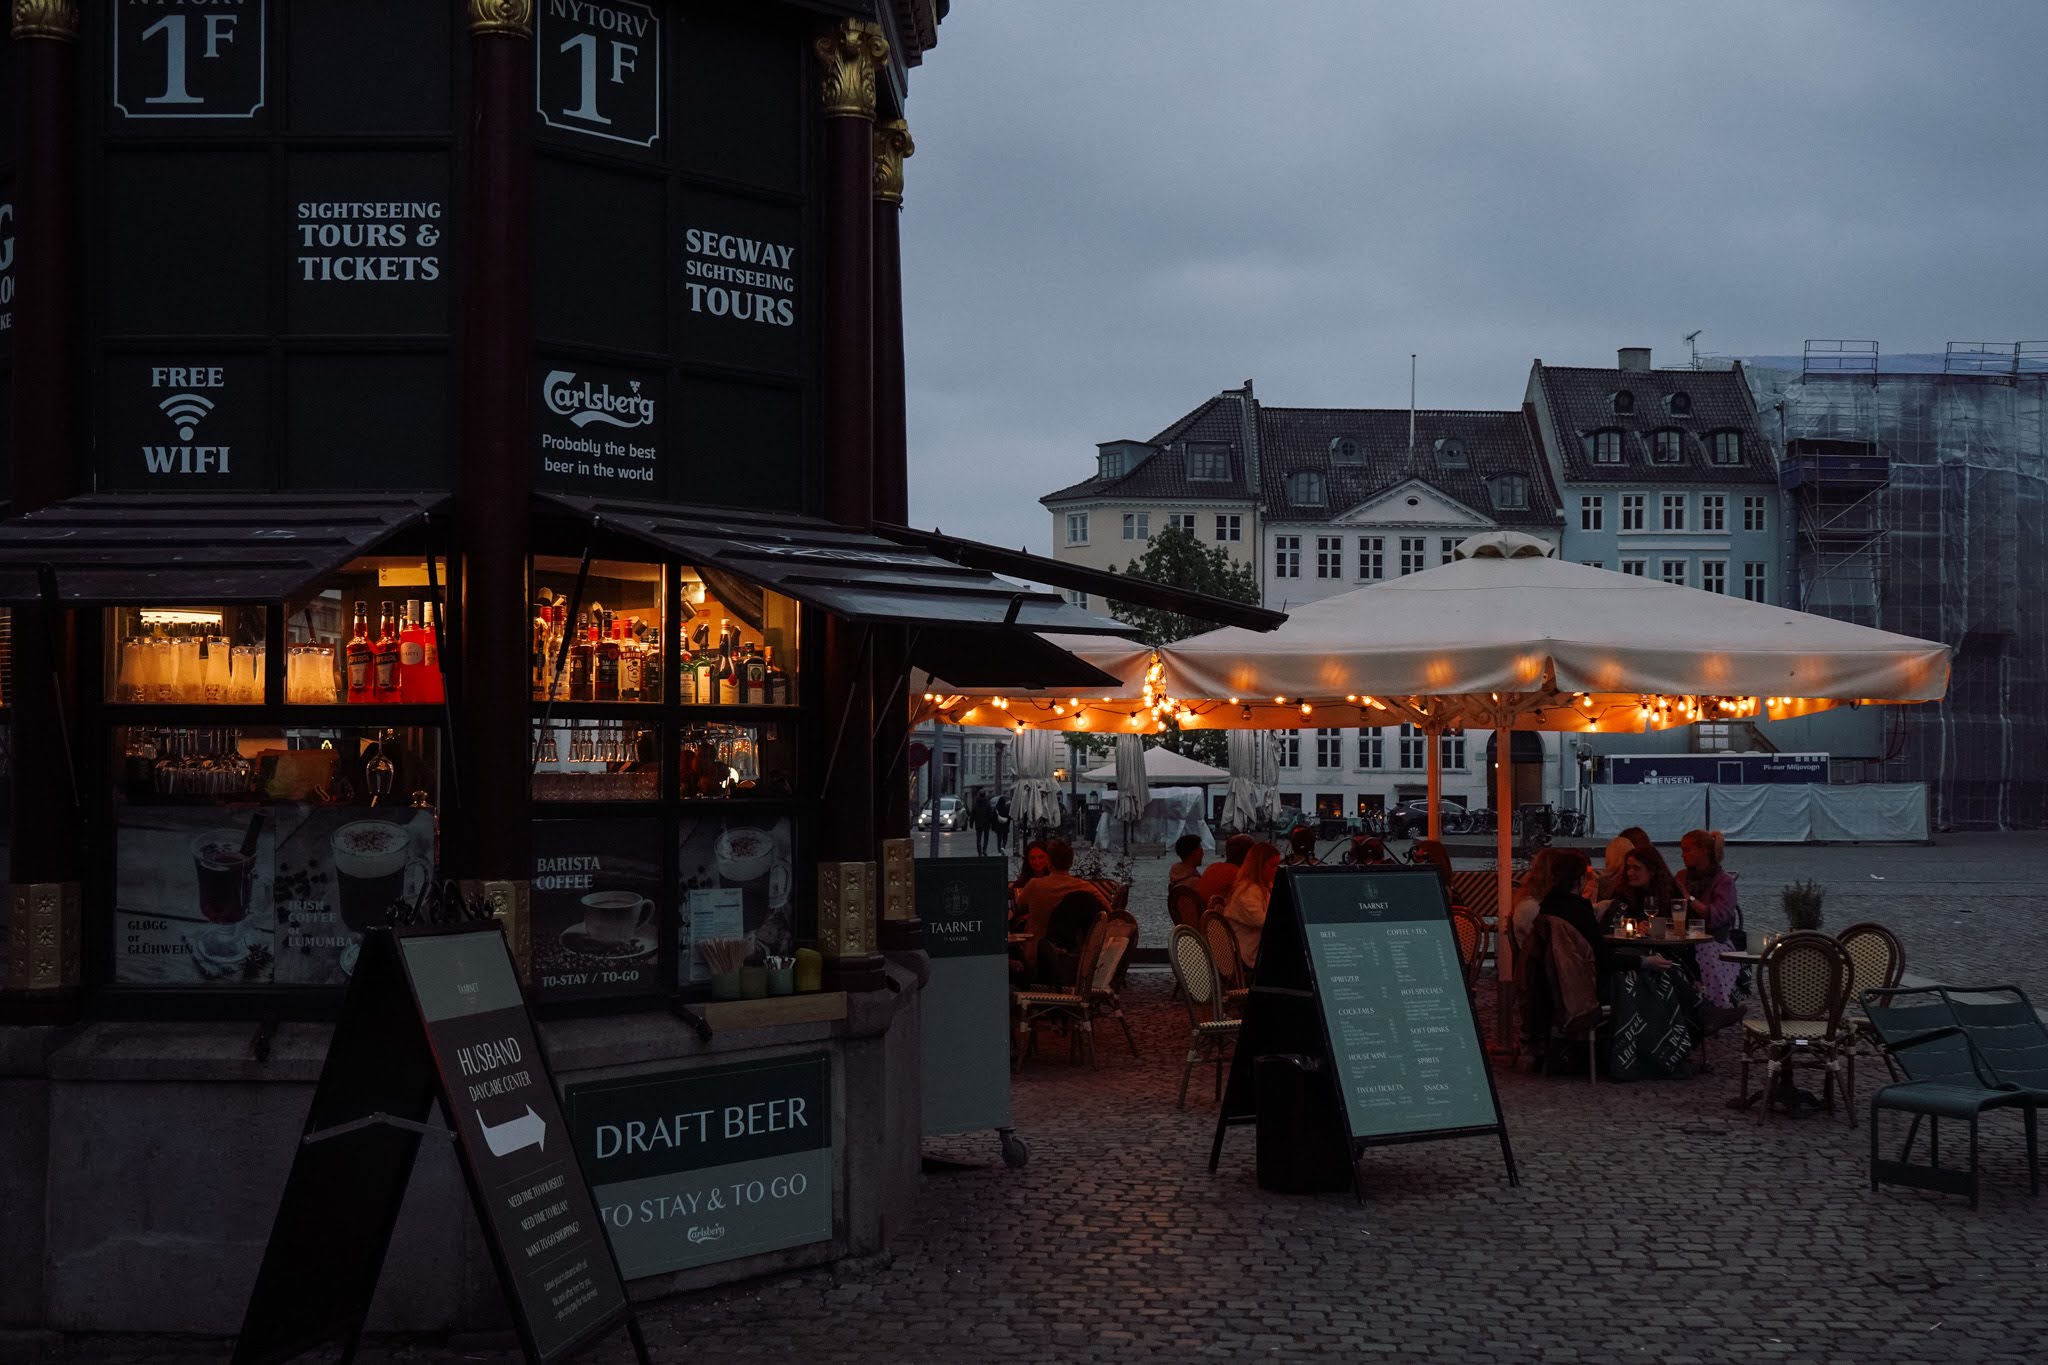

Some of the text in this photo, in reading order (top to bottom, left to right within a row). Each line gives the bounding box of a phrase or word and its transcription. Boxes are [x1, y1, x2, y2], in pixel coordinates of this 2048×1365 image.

[549, 0, 648, 38] NYTORV
[298, 203, 440, 218] SIGHTSEEING
[299, 224, 439, 246] TOURS &
[686, 228, 794, 270] SEGWAY
[298, 257, 439, 280] TICKETS
[686, 259, 794, 293] SIGHTSEEING
[685, 282, 794, 327] TOURS
[152, 368, 224, 387] FREE
[544, 371, 654, 427] Carlsberg
[542, 433, 656, 460] Probably the best
[142, 447, 230, 473] WIFI
[544, 459, 655, 482] beer in the world
[536, 856, 601, 872] BARISTA
[536, 873, 593, 890] COFFEE
[288, 901, 324, 911] IRISH
[1358, 902, 1389, 910] TAARNET
[288, 912, 337, 924] COFFEE
[929, 920, 983, 934] TAARNET
[288, 927, 300, 935] or
[288, 936, 353, 947] LUMUMBA
[128, 943, 193, 954] GLÜHWEIN
[542, 974, 588, 987] TO-STAY
[602, 970, 639, 983] TO-GO
[1338, 1007, 1375, 1016] COCKTAILS
[457, 1037, 522, 1076] HUSBAND
[468, 1070, 532, 1102] DAYCARE CENTER
[596, 1096, 808, 1159] DRAFT BEER
[508, 1194, 522, 1208] NEED
[521, 1189, 533, 1202] TIME
[533, 1185, 541, 1196] TO
[600, 1173, 807, 1227] TO STAY & TO GO
[521, 1216, 535, 1230] NEED
[545, 1207, 553, 1218] TO
[687, 1223, 725, 1243] Carlsberg
[526, 1241, 541, 1257] WANT
[540, 1238, 548, 1249] TO
[546, 1234, 556, 1245] GO
